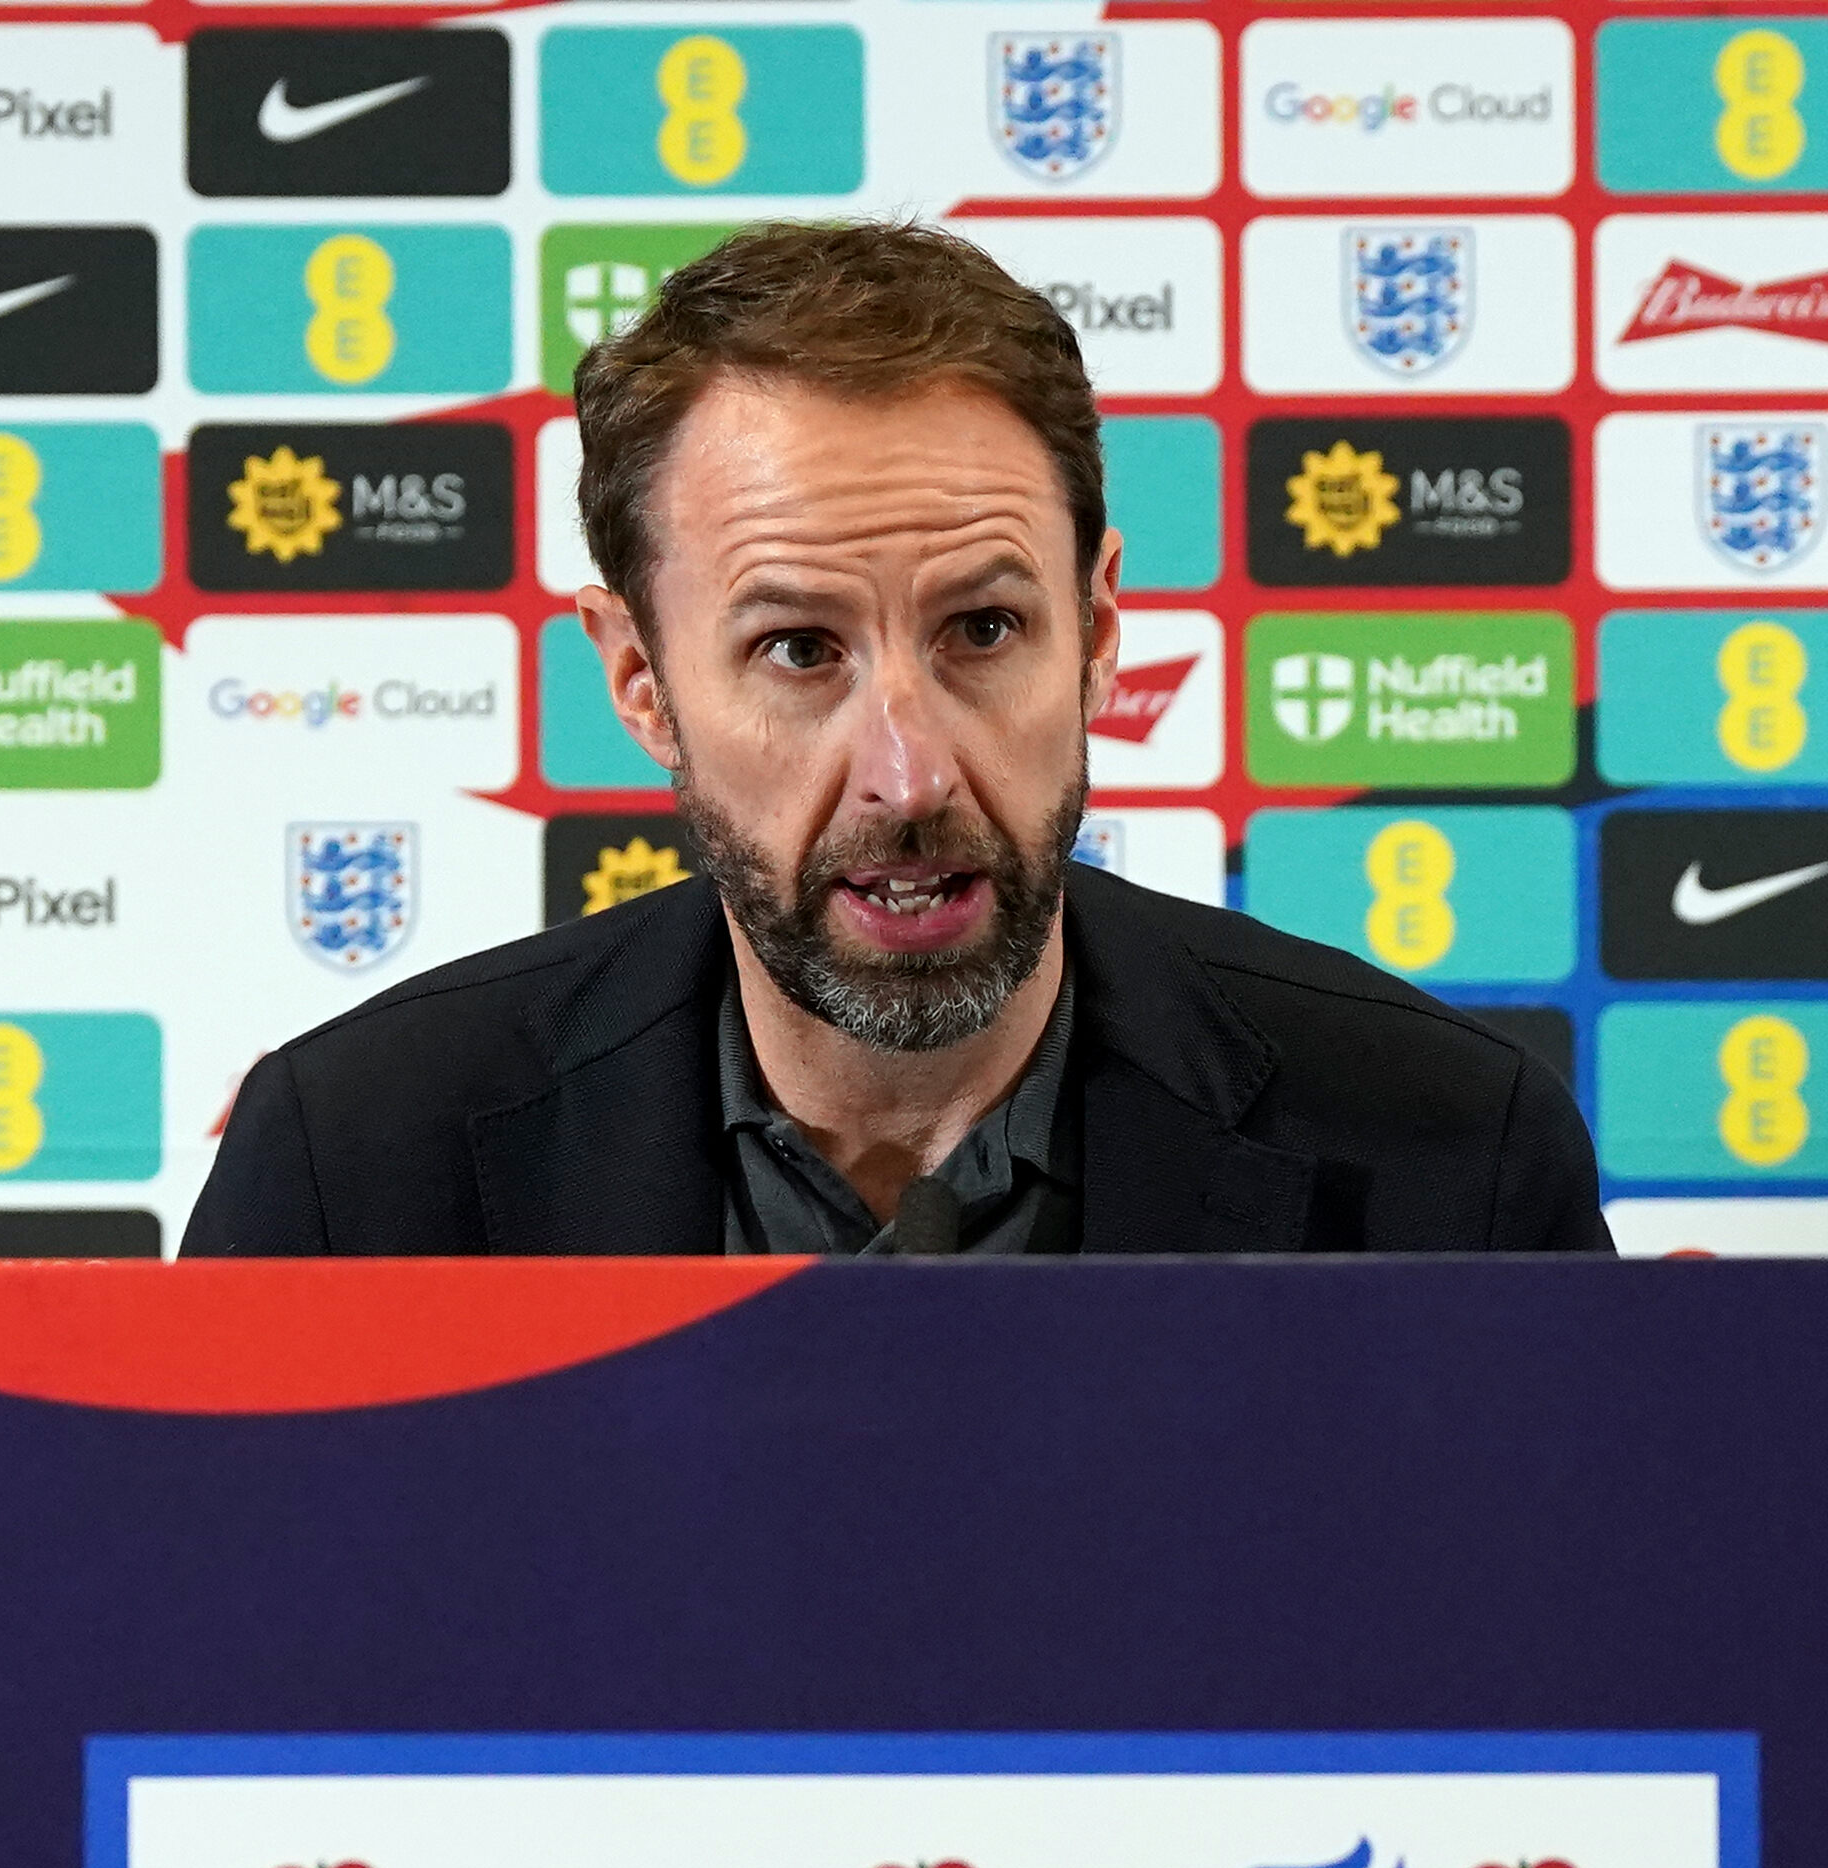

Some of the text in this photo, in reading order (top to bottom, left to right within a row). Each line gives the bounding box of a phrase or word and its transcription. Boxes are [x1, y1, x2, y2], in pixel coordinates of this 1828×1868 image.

[1265, 82, 1552, 133] Google Cloud
[353, 474, 465, 520] M&S
[1411, 468, 1523, 514] M&S
[1368, 655, 1547, 699] Nuffield
[209, 678, 496, 729] Google Cloud
[1368, 699, 1517, 741] Health
